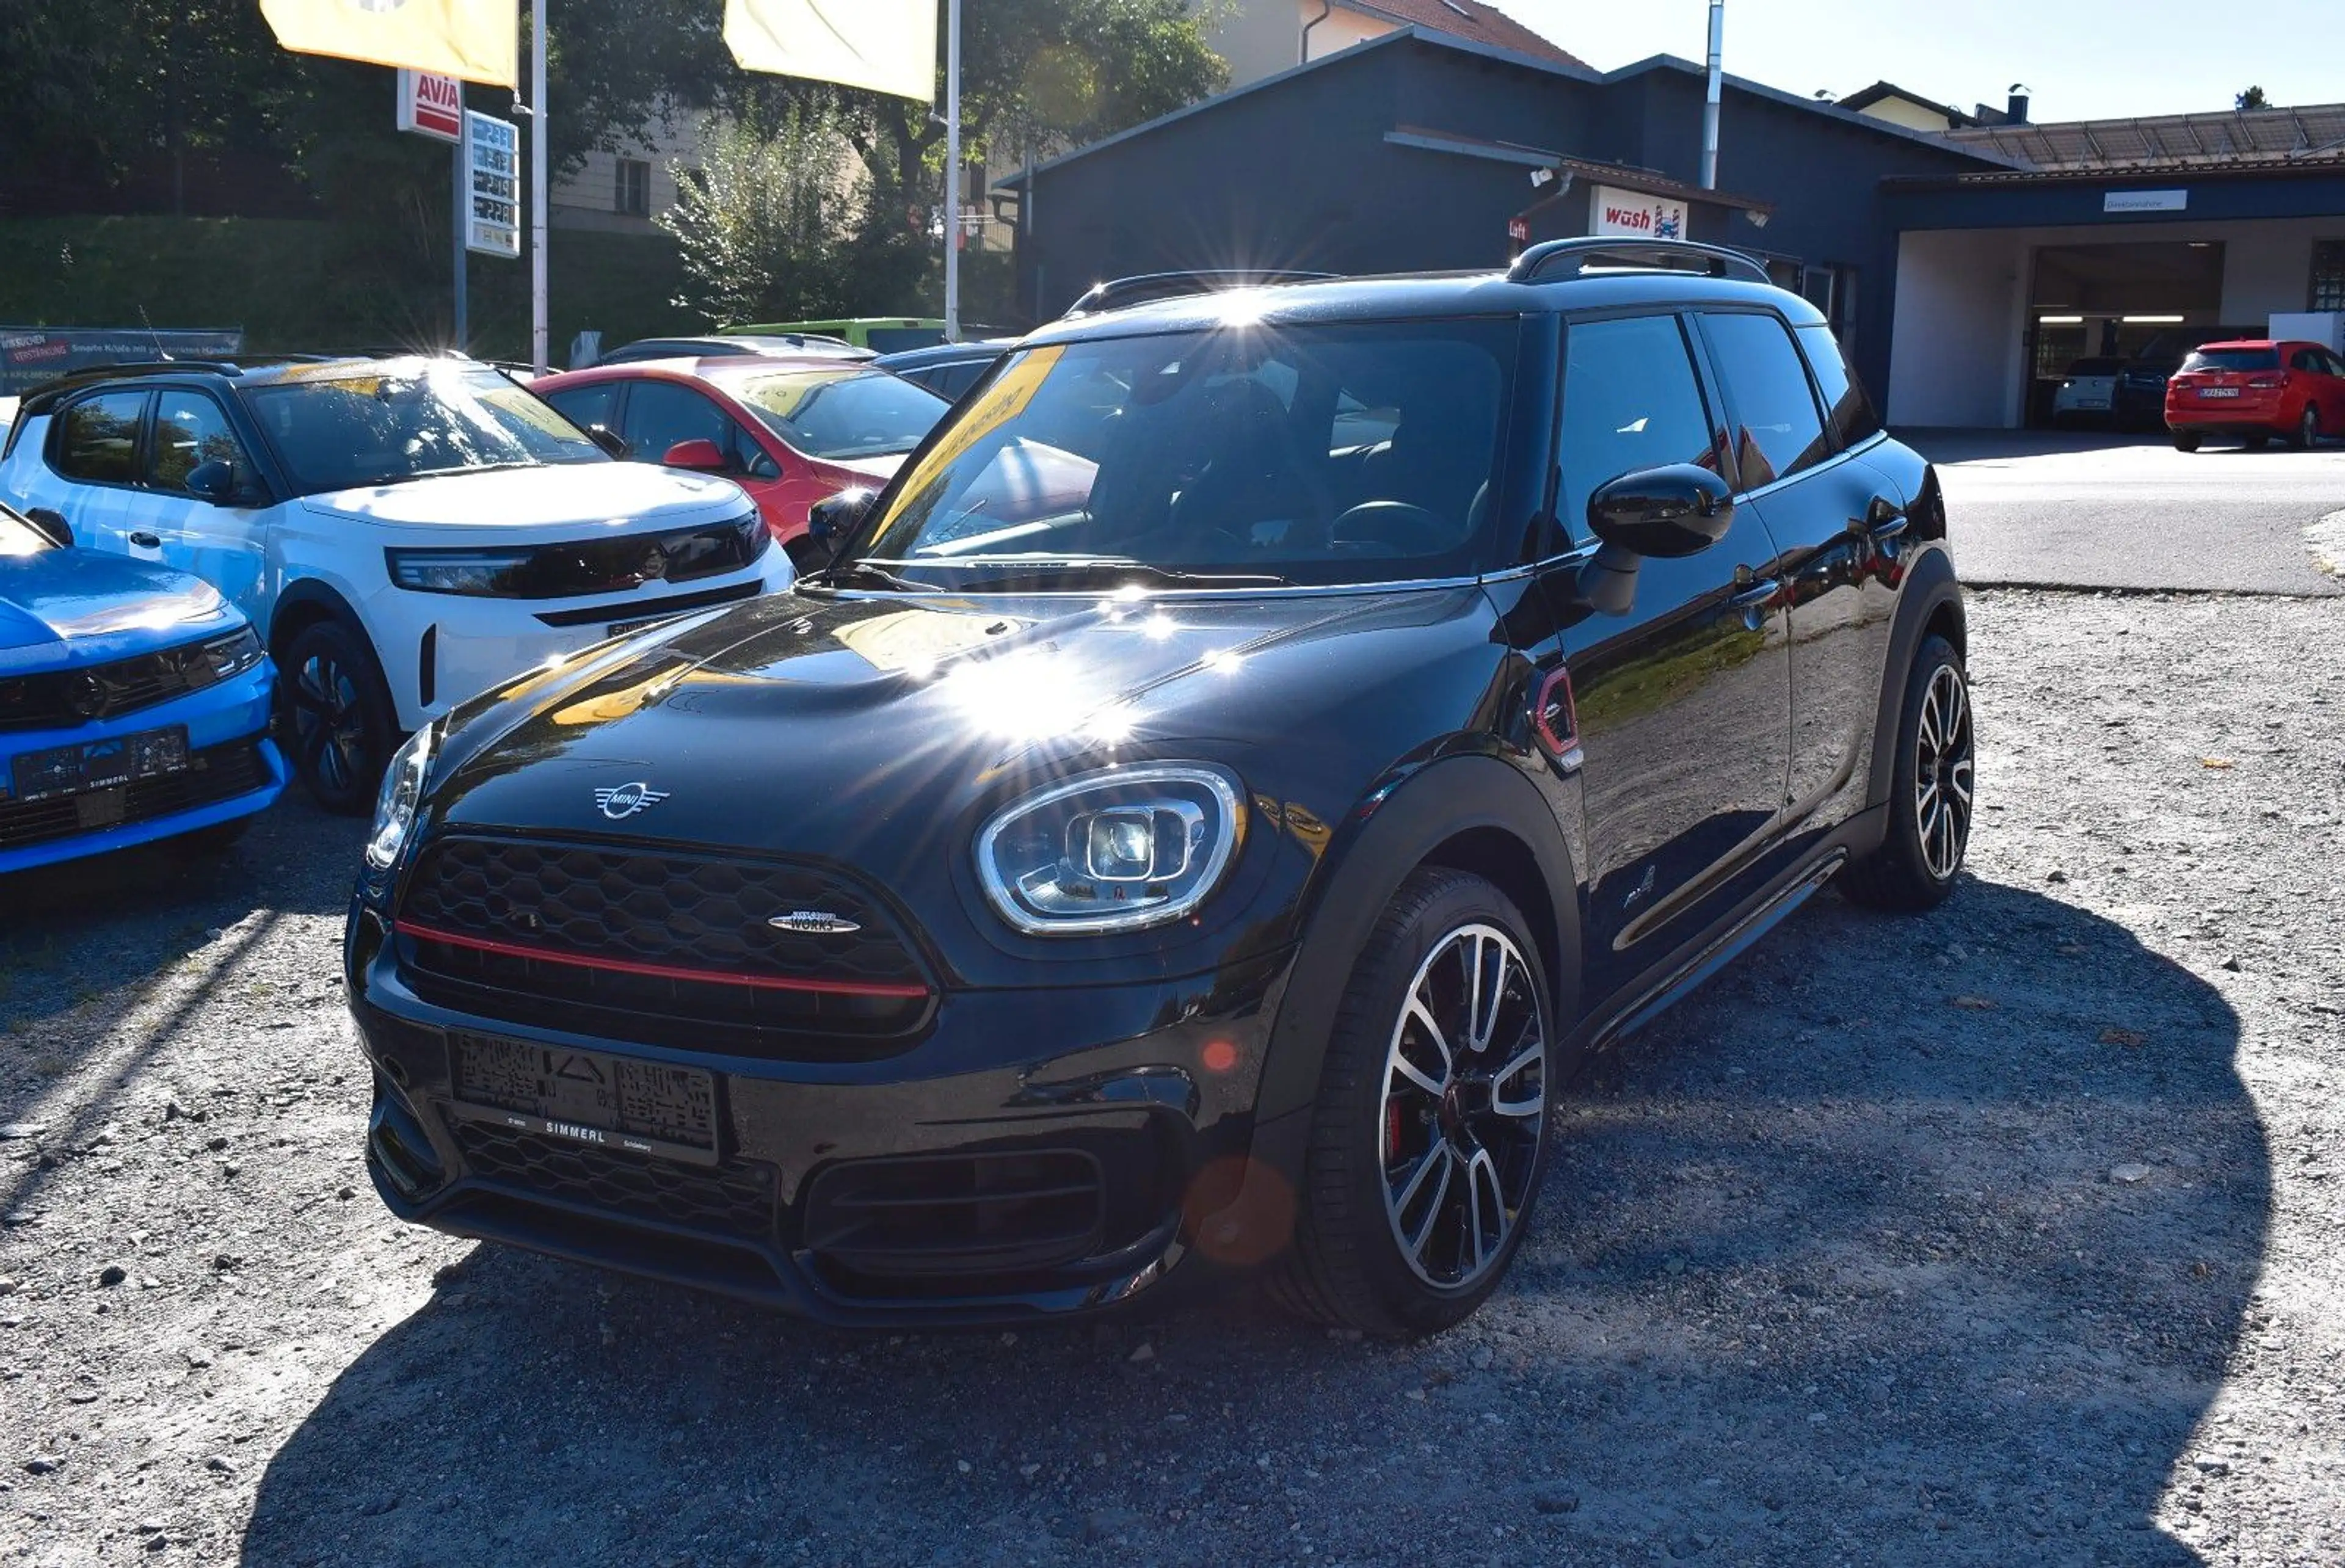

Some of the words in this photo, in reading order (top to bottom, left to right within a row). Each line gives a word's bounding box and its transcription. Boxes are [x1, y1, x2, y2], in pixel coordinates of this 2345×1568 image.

[416, 74, 459, 110] AVIA
[1509, 220, 1525, 240] Luft
[609, 794, 639, 805] MINI
[791, 918, 834, 931] WORKS
[546, 1122, 605, 1142] SIMMERL
